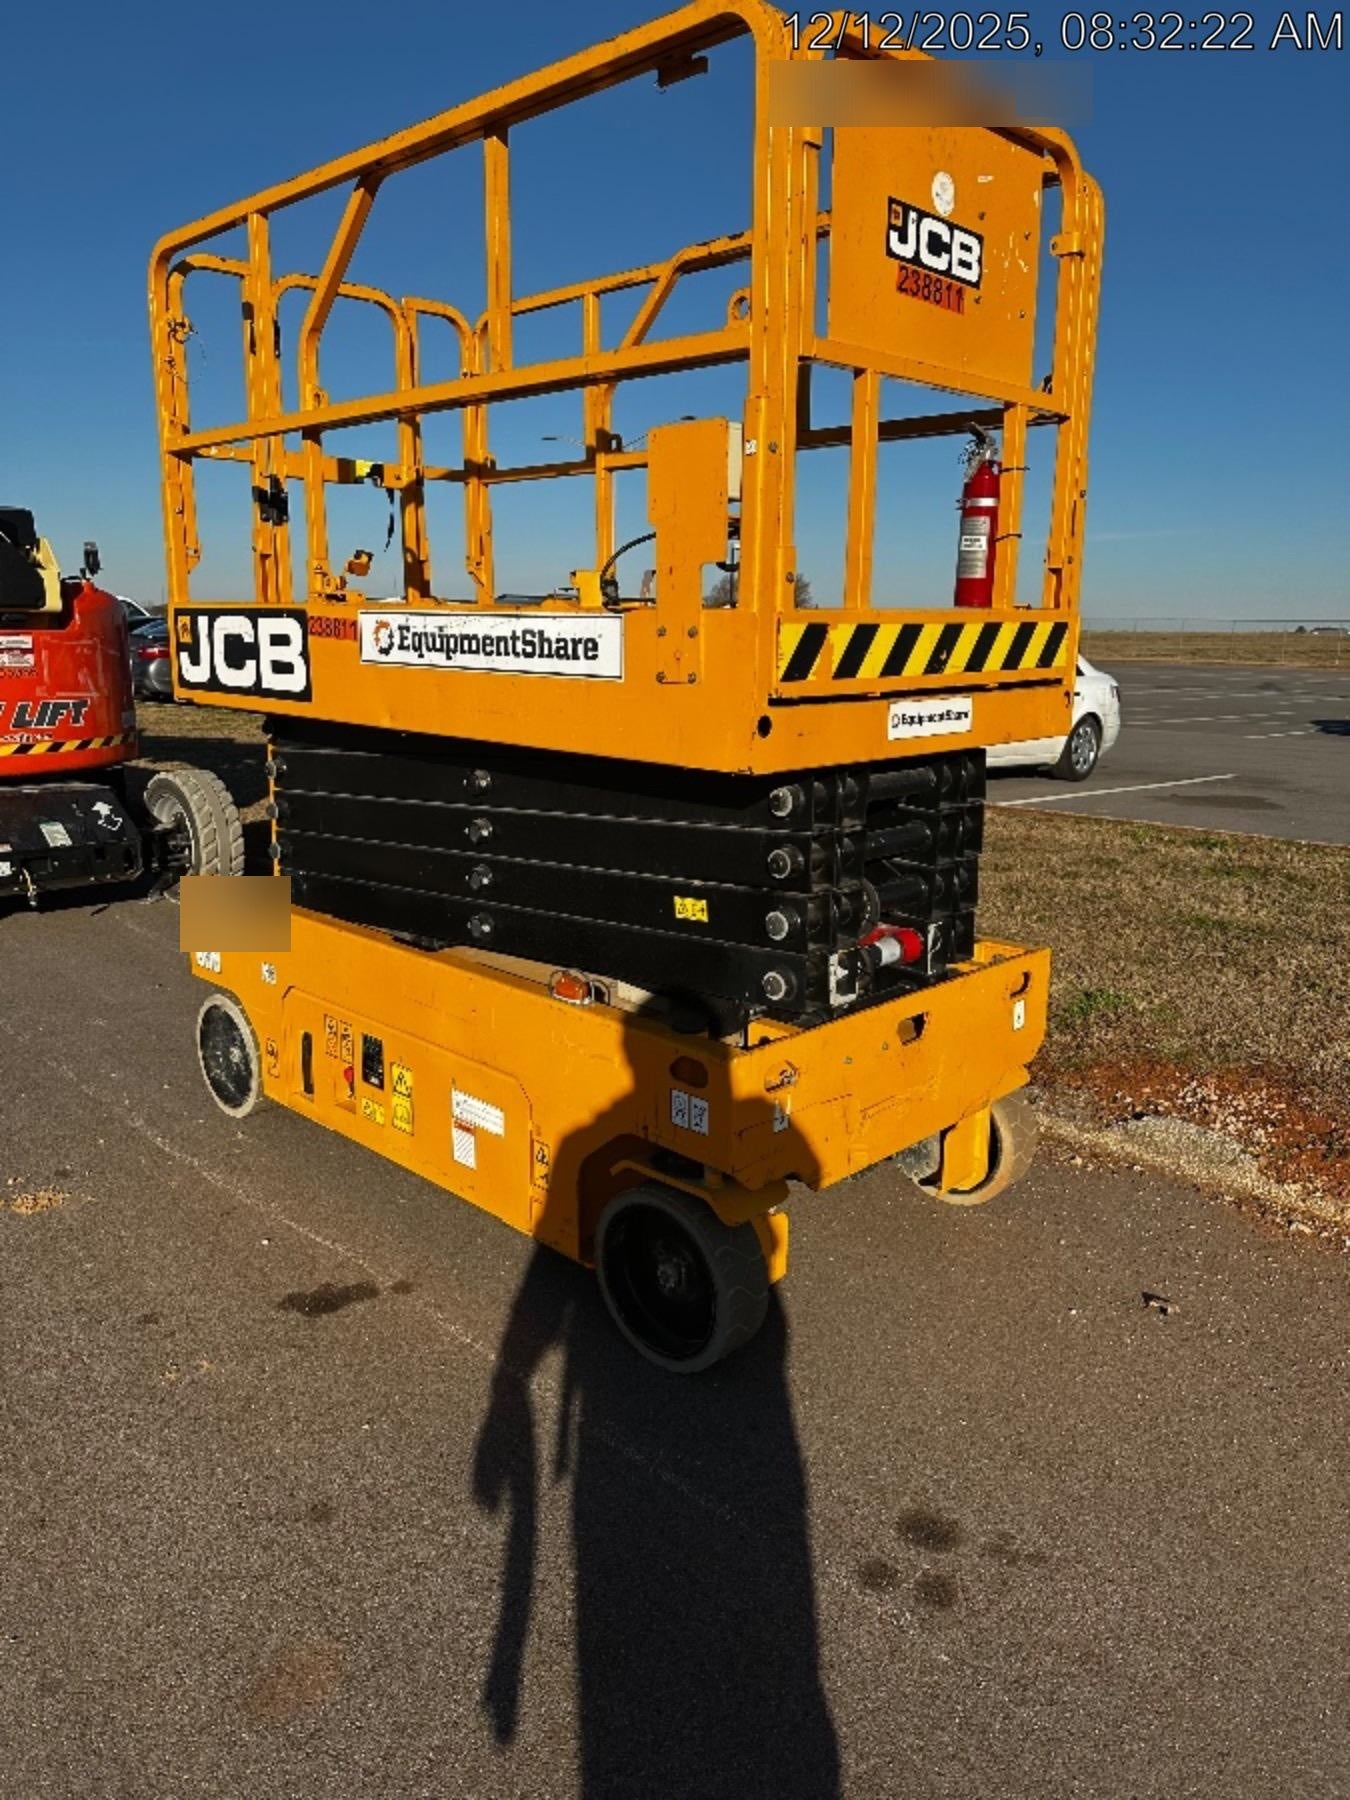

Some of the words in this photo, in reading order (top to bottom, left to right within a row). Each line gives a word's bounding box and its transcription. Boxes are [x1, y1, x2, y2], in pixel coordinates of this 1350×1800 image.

[889, 209, 981, 283] JCB
[896, 264, 964, 315] 238811
[179, 615, 307, 693] JCB
[397, 624, 599, 661] EquipmentShare
[10, 699, 91, 731] LIFT
